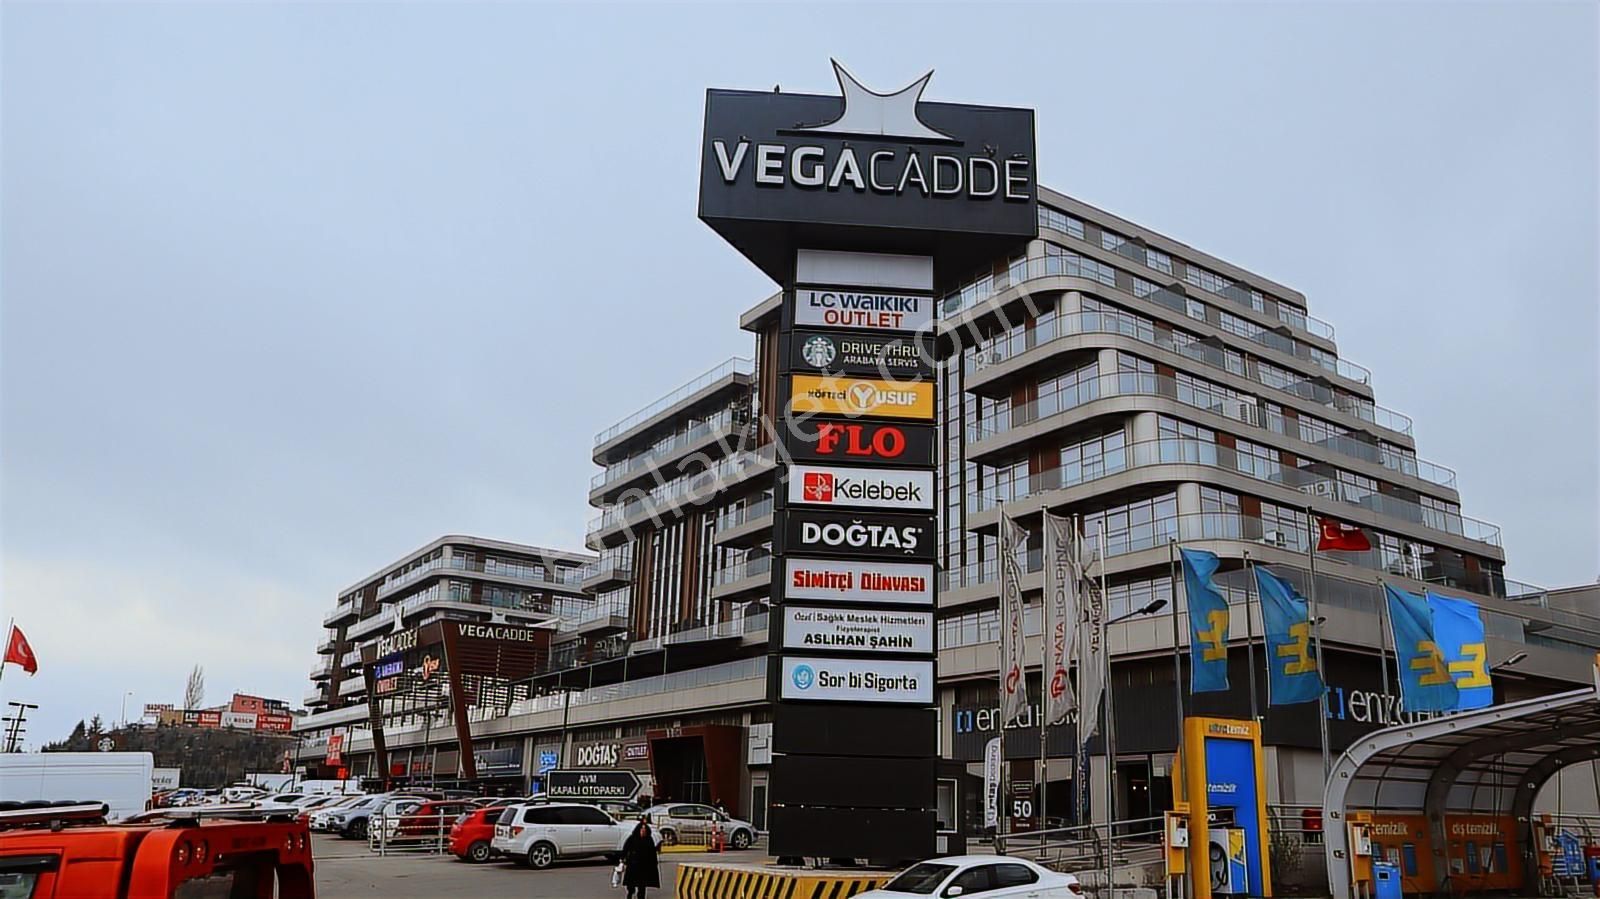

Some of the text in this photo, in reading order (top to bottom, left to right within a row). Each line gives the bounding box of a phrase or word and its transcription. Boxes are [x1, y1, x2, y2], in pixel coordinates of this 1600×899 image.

[713, 141, 1030, 199] VEGACADDE
[810, 292, 836, 307] LC
[824, 309, 904, 328] OUTLET
[841, 342, 921, 357] DRIVE THRU
[843, 356, 886, 366] ARABAYA
[807, 388, 847, 400] KÖFTECİ
[815, 422, 906, 458] FLO
[834, 478, 922, 502] Kelebek
[802, 519, 919, 554] DOĞTAŞ
[816, 612, 845, 624] Sağlık
[847, 613, 878, 624] Meslek
[880, 615, 926, 625] Hizmetleri
[458, 623, 535, 642] VEGACADDE
[804, 633, 913, 648] ASLIHAN ŞAHİN
[1054, 622, 1065, 666] NATA
[818, 671, 918, 692] Sor bi Sigorta
[577, 742, 618, 768] DOĞTAŞ
[578, 775, 597, 783] AVM
[550, 786, 626, 795] KAPALI OTOPARKI
[1013, 800, 1032, 818] 50
